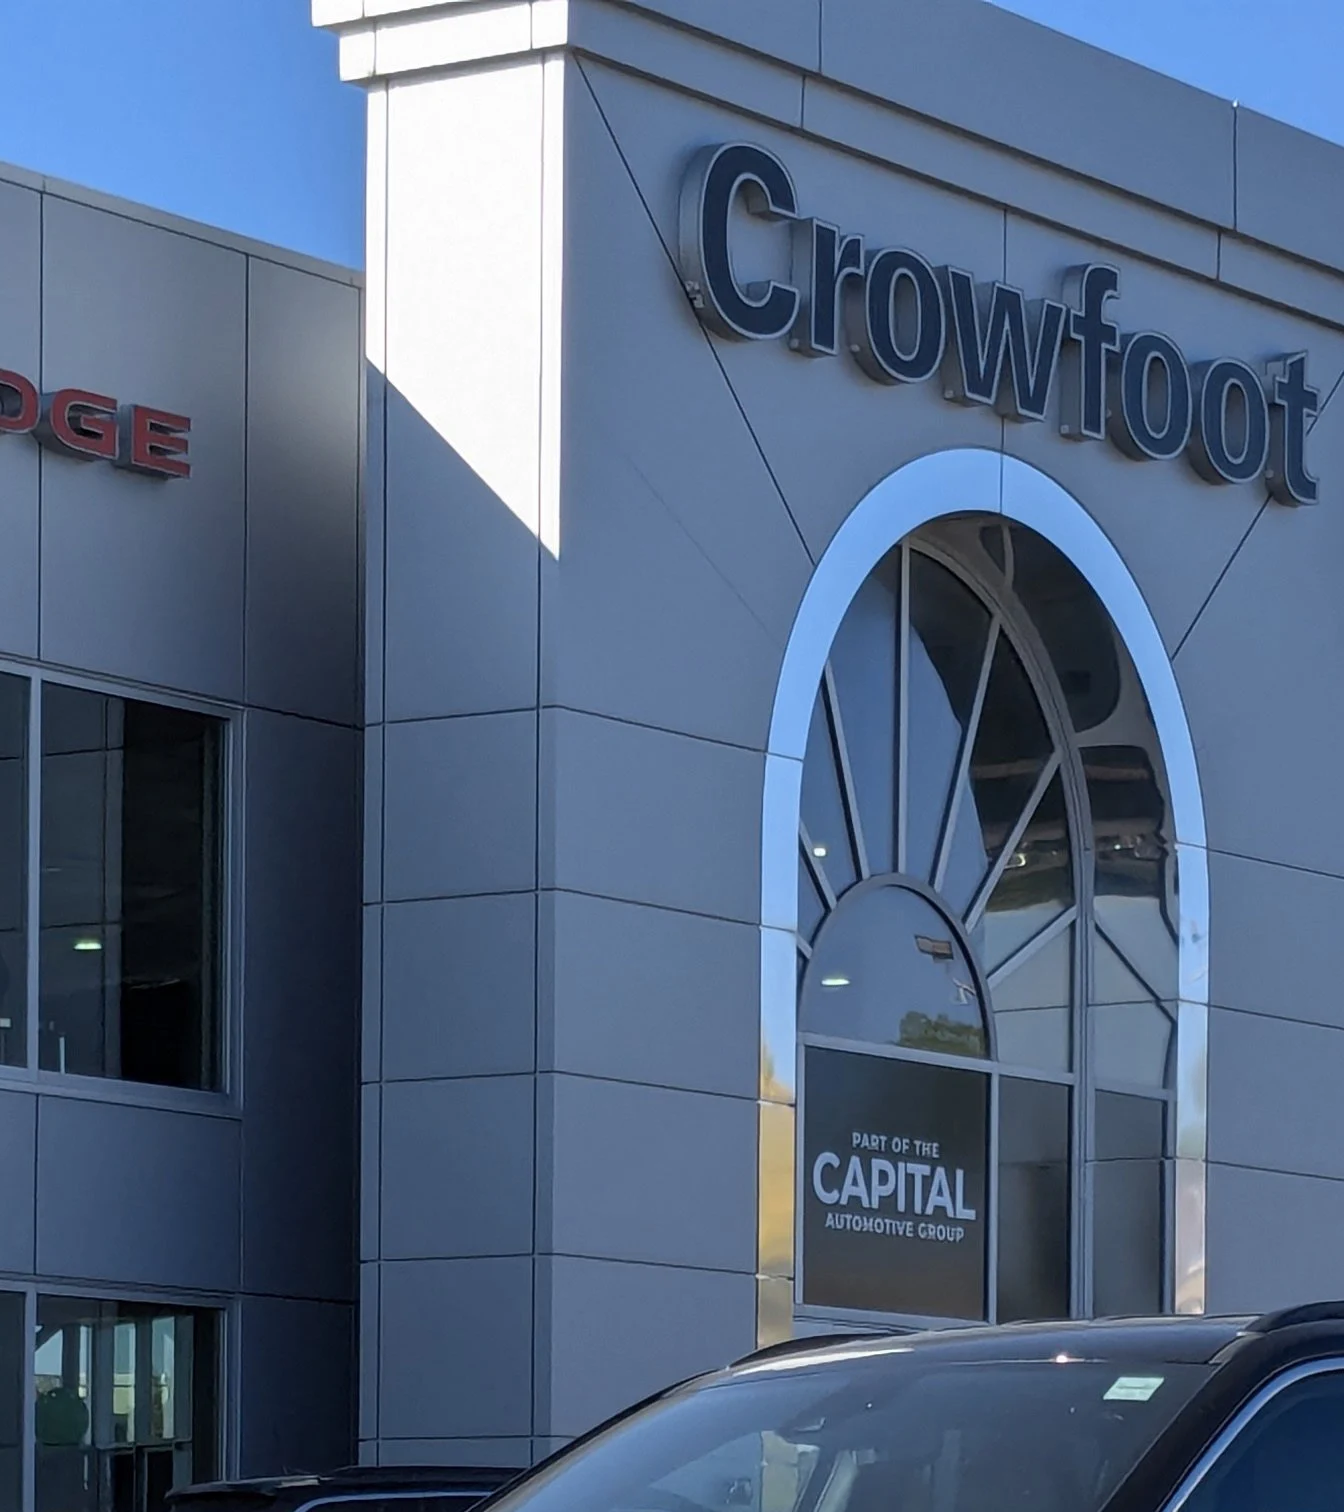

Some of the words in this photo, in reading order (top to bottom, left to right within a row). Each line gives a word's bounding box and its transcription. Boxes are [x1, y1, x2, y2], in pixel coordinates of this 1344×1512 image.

[696, 140, 1320, 507] Crowfoot
[851, 1131, 888, 1152] PART
[891, 1136, 910, 1155] OF
[913, 1139, 940, 1159] THE
[812, 1151, 977, 1221] CAPITAL
[824, 1212, 914, 1238] AUTOMOTIVE
[917, 1222, 965, 1243] GROUP
